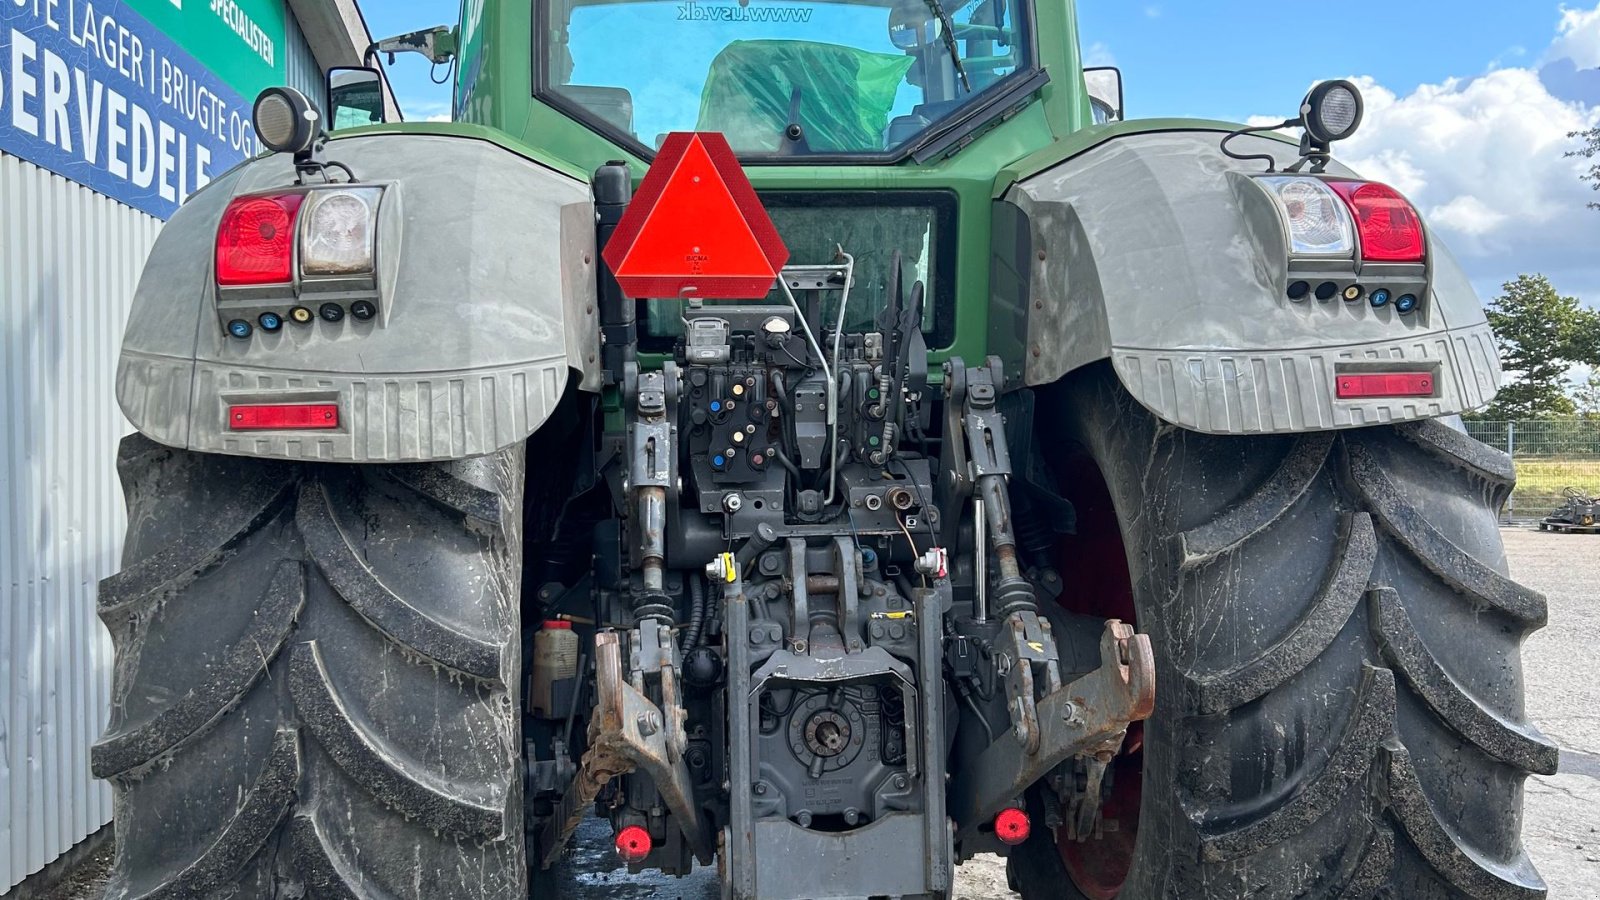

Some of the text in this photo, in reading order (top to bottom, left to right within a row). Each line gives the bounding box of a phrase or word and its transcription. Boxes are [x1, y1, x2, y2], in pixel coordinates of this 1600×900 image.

[69, 0, 144, 88] LAGER
[151, 48, 155, 95] I
[161, 56, 226, 143] BRUGTE
[230, 110, 251, 159] OG
[209, 0, 275, 68] SPECIALISTEN
[0, 27, 211, 207] ERVEDELE
